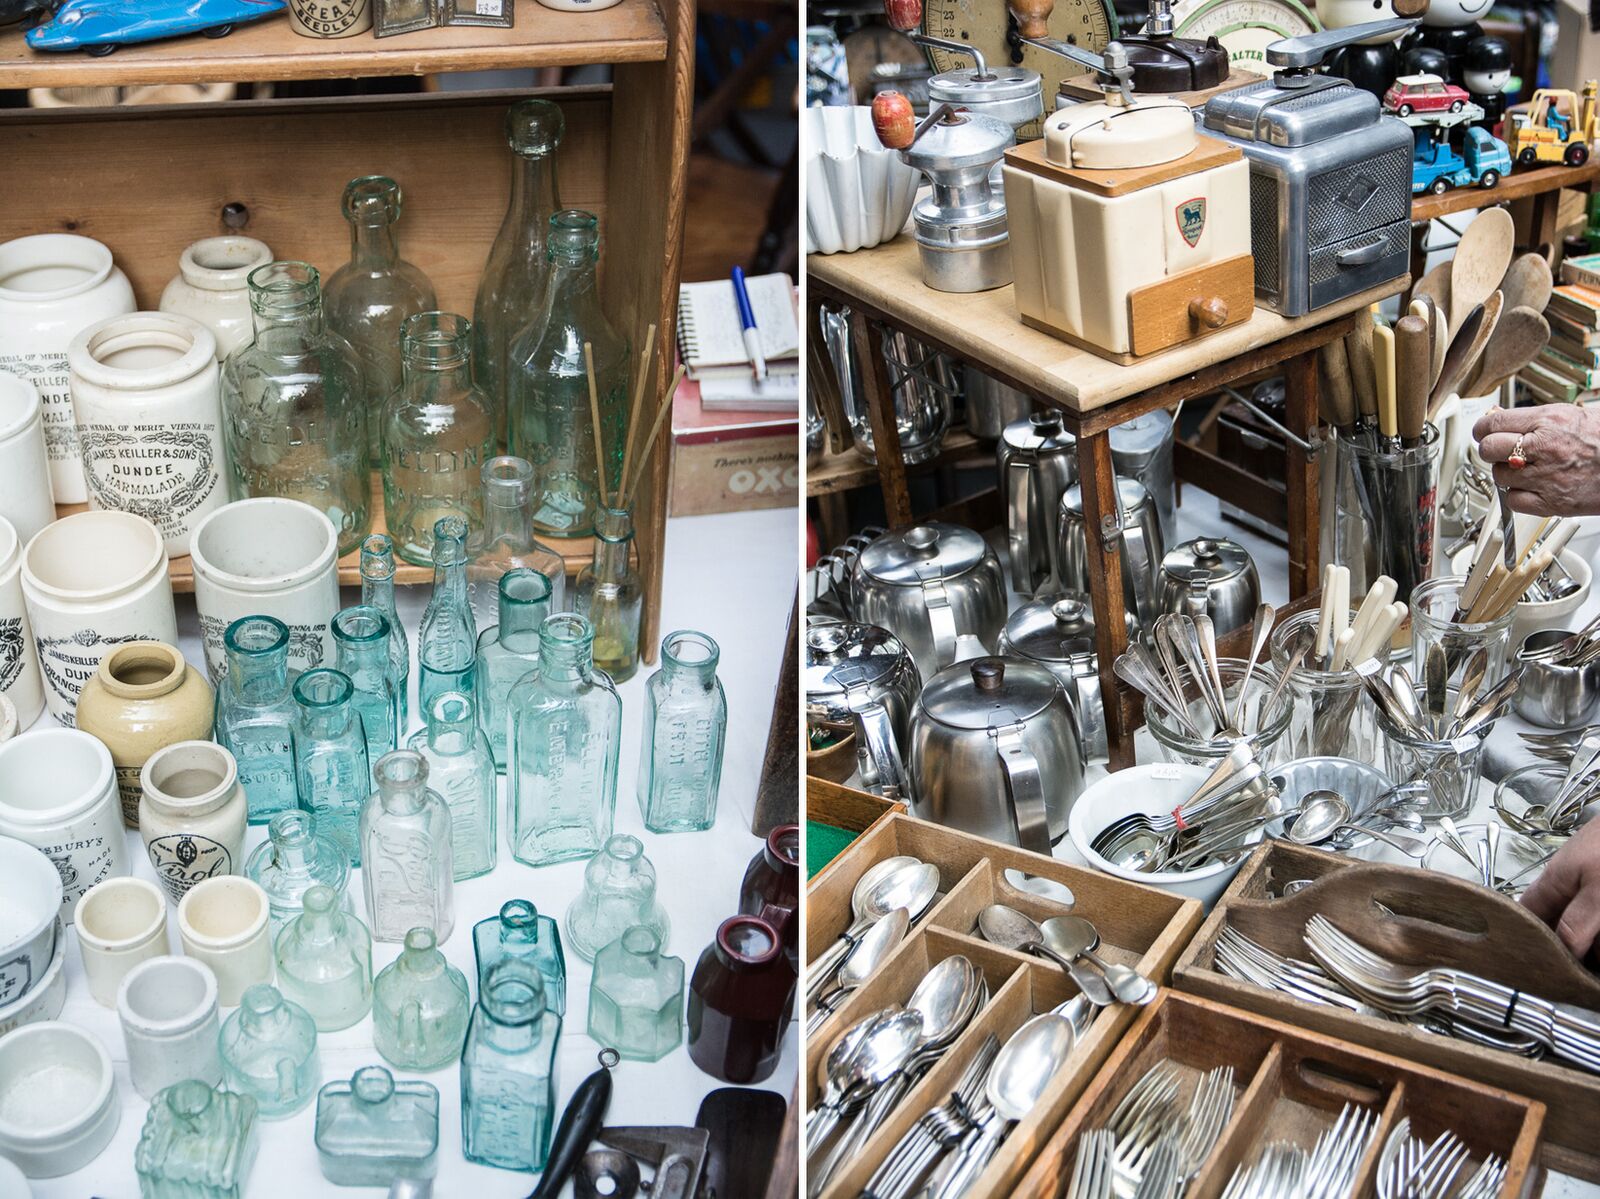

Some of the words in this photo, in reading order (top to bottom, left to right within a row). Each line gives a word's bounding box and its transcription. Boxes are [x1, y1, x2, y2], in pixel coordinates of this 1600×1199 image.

[299, 0, 352, 19] REAM
[943, 11, 955, 20] 23
[1082, 15, 1089, 24] 6
[943, 28, 955, 37] 22
[1086, 32, 1092, 41] 7
[1229, 50, 1264, 62] ALTER
[29, 376, 70, 388] EILLER
[90, 424, 115, 432] MEDAL
[117, 424, 130, 432] OF
[134, 423, 165, 432] MERIT
[171, 422, 201, 431] VIENNA
[112, 463, 173, 476] DUNDEE
[104, 472, 186, 496] MARMALADE
[177, 473, 220, 519] MARMALADE
[48, 649, 70, 662] JAMES
[70, 656, 99, 666] KEILLER
[44, 663, 82, 695] ORANGE
[64, 667, 93, 681] DUN
[669, 719, 688, 767] FRUIT
